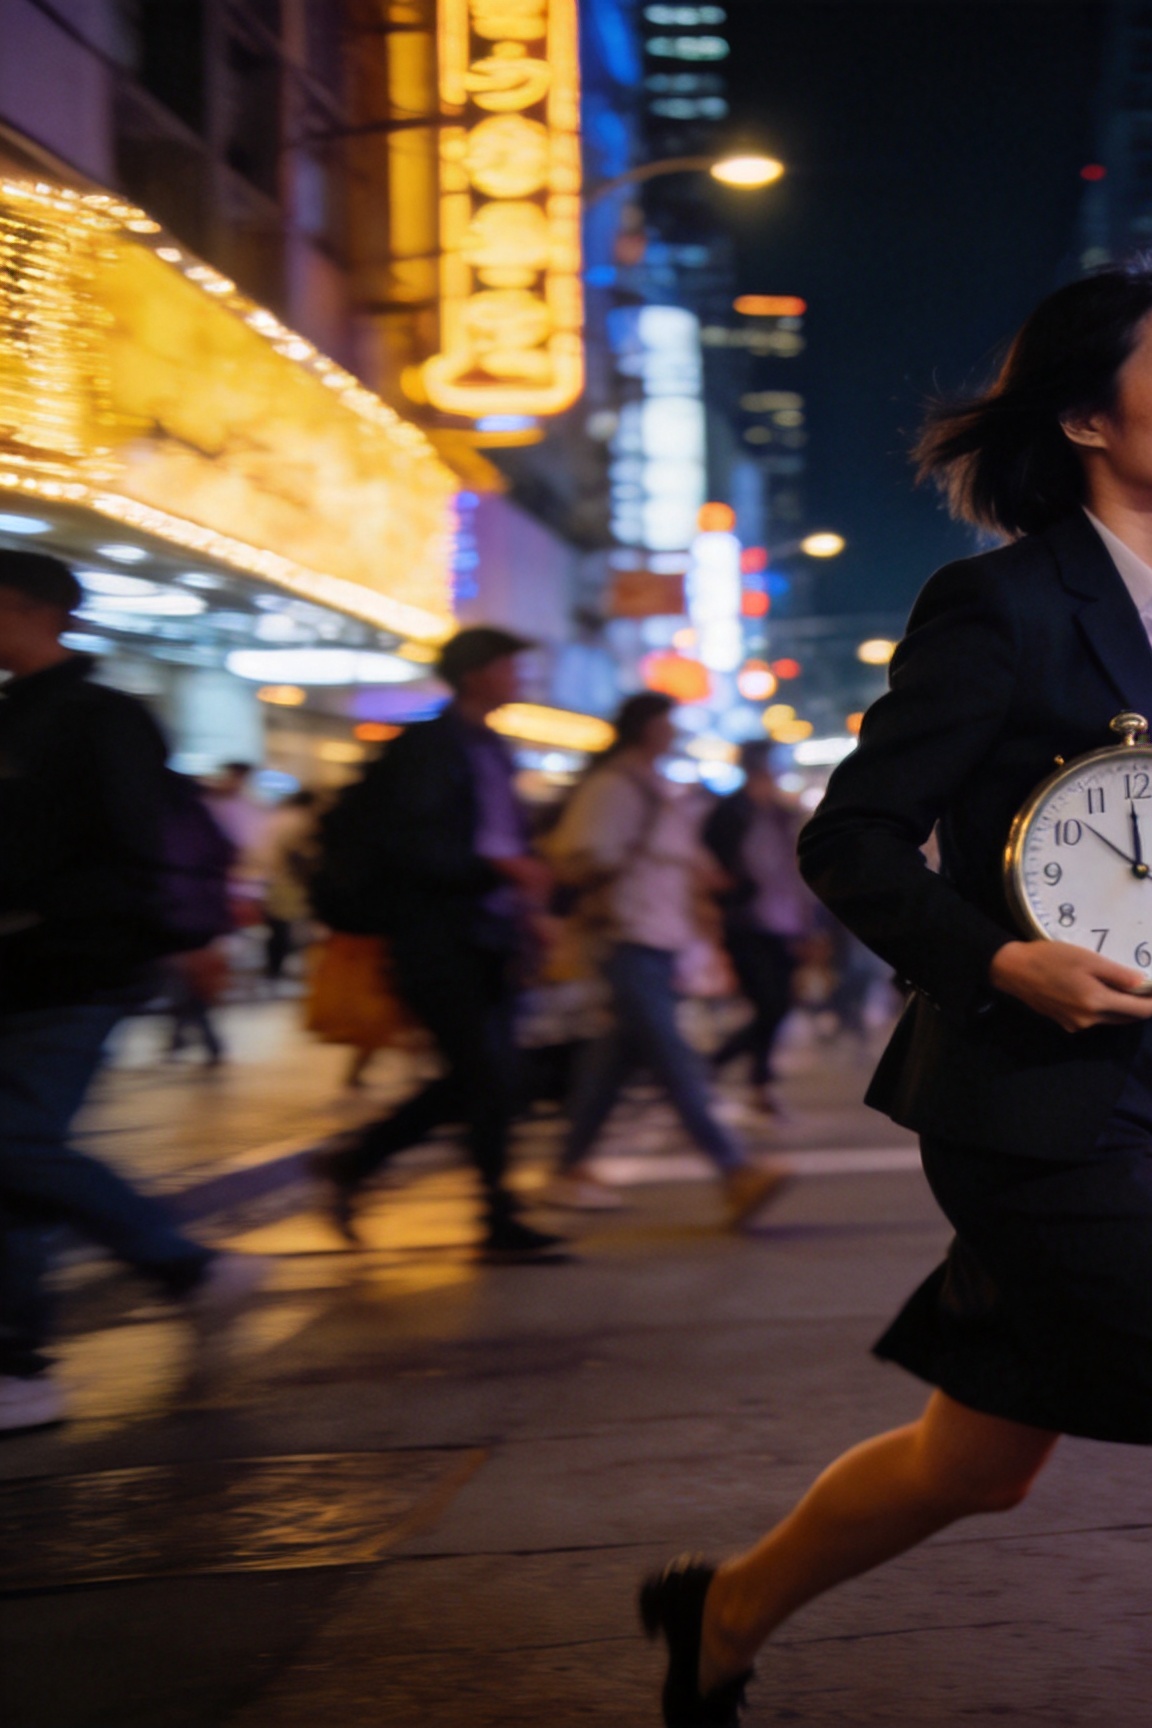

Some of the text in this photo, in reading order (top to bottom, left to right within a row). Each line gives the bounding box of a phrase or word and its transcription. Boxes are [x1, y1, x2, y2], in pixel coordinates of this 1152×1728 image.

[1123, 773, 1152, 800] 12
[1086, 787, 1105, 814] 11
[1054, 818, 1083, 846] 10
[1043, 861, 1063, 886] 9
[1057, 902, 1076, 928] 8
[1090, 928, 1110, 952] 7
[1134, 941, 1152, 968] 6
